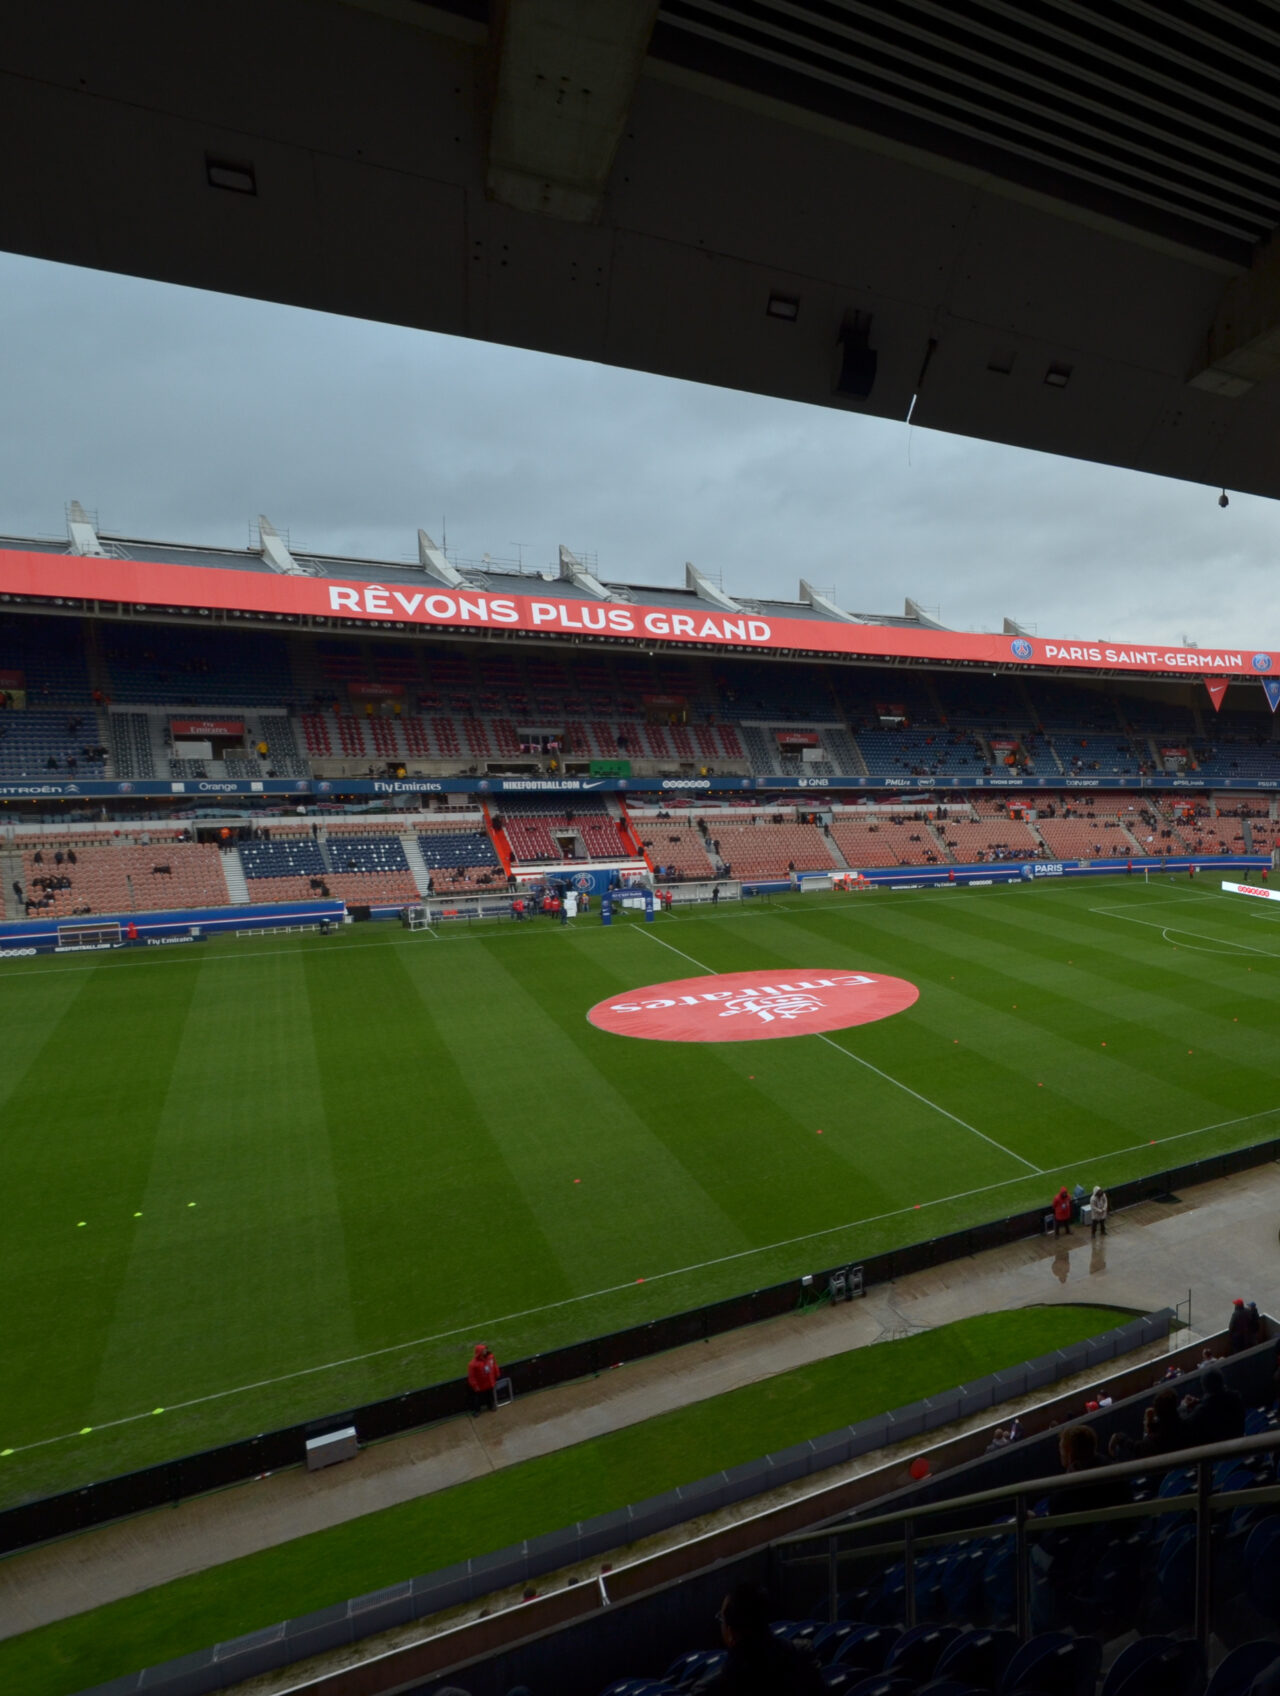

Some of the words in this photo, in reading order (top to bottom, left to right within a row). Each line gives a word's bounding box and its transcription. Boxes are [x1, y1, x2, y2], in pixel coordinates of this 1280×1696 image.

[329, 585, 520, 623] RÊVONS
[531, 603, 634, 631] PLUS
[645, 613, 771, 642] GRAND
[1045, 645, 1102, 661] PARIS
[1105, 650, 1242, 667] SAINT-GERMAIN
[199, 782, 237, 792] Orange
[394, 781, 442, 791] Emirates
[503, 781, 580, 789] NIKEFOOTBALL.COM
[809, 778, 829, 786] QNB
[1034, 864, 1063, 873] PARIS
[1238, 885, 1270, 897] ooredoo
[610, 975, 879, 1013] Emirates
